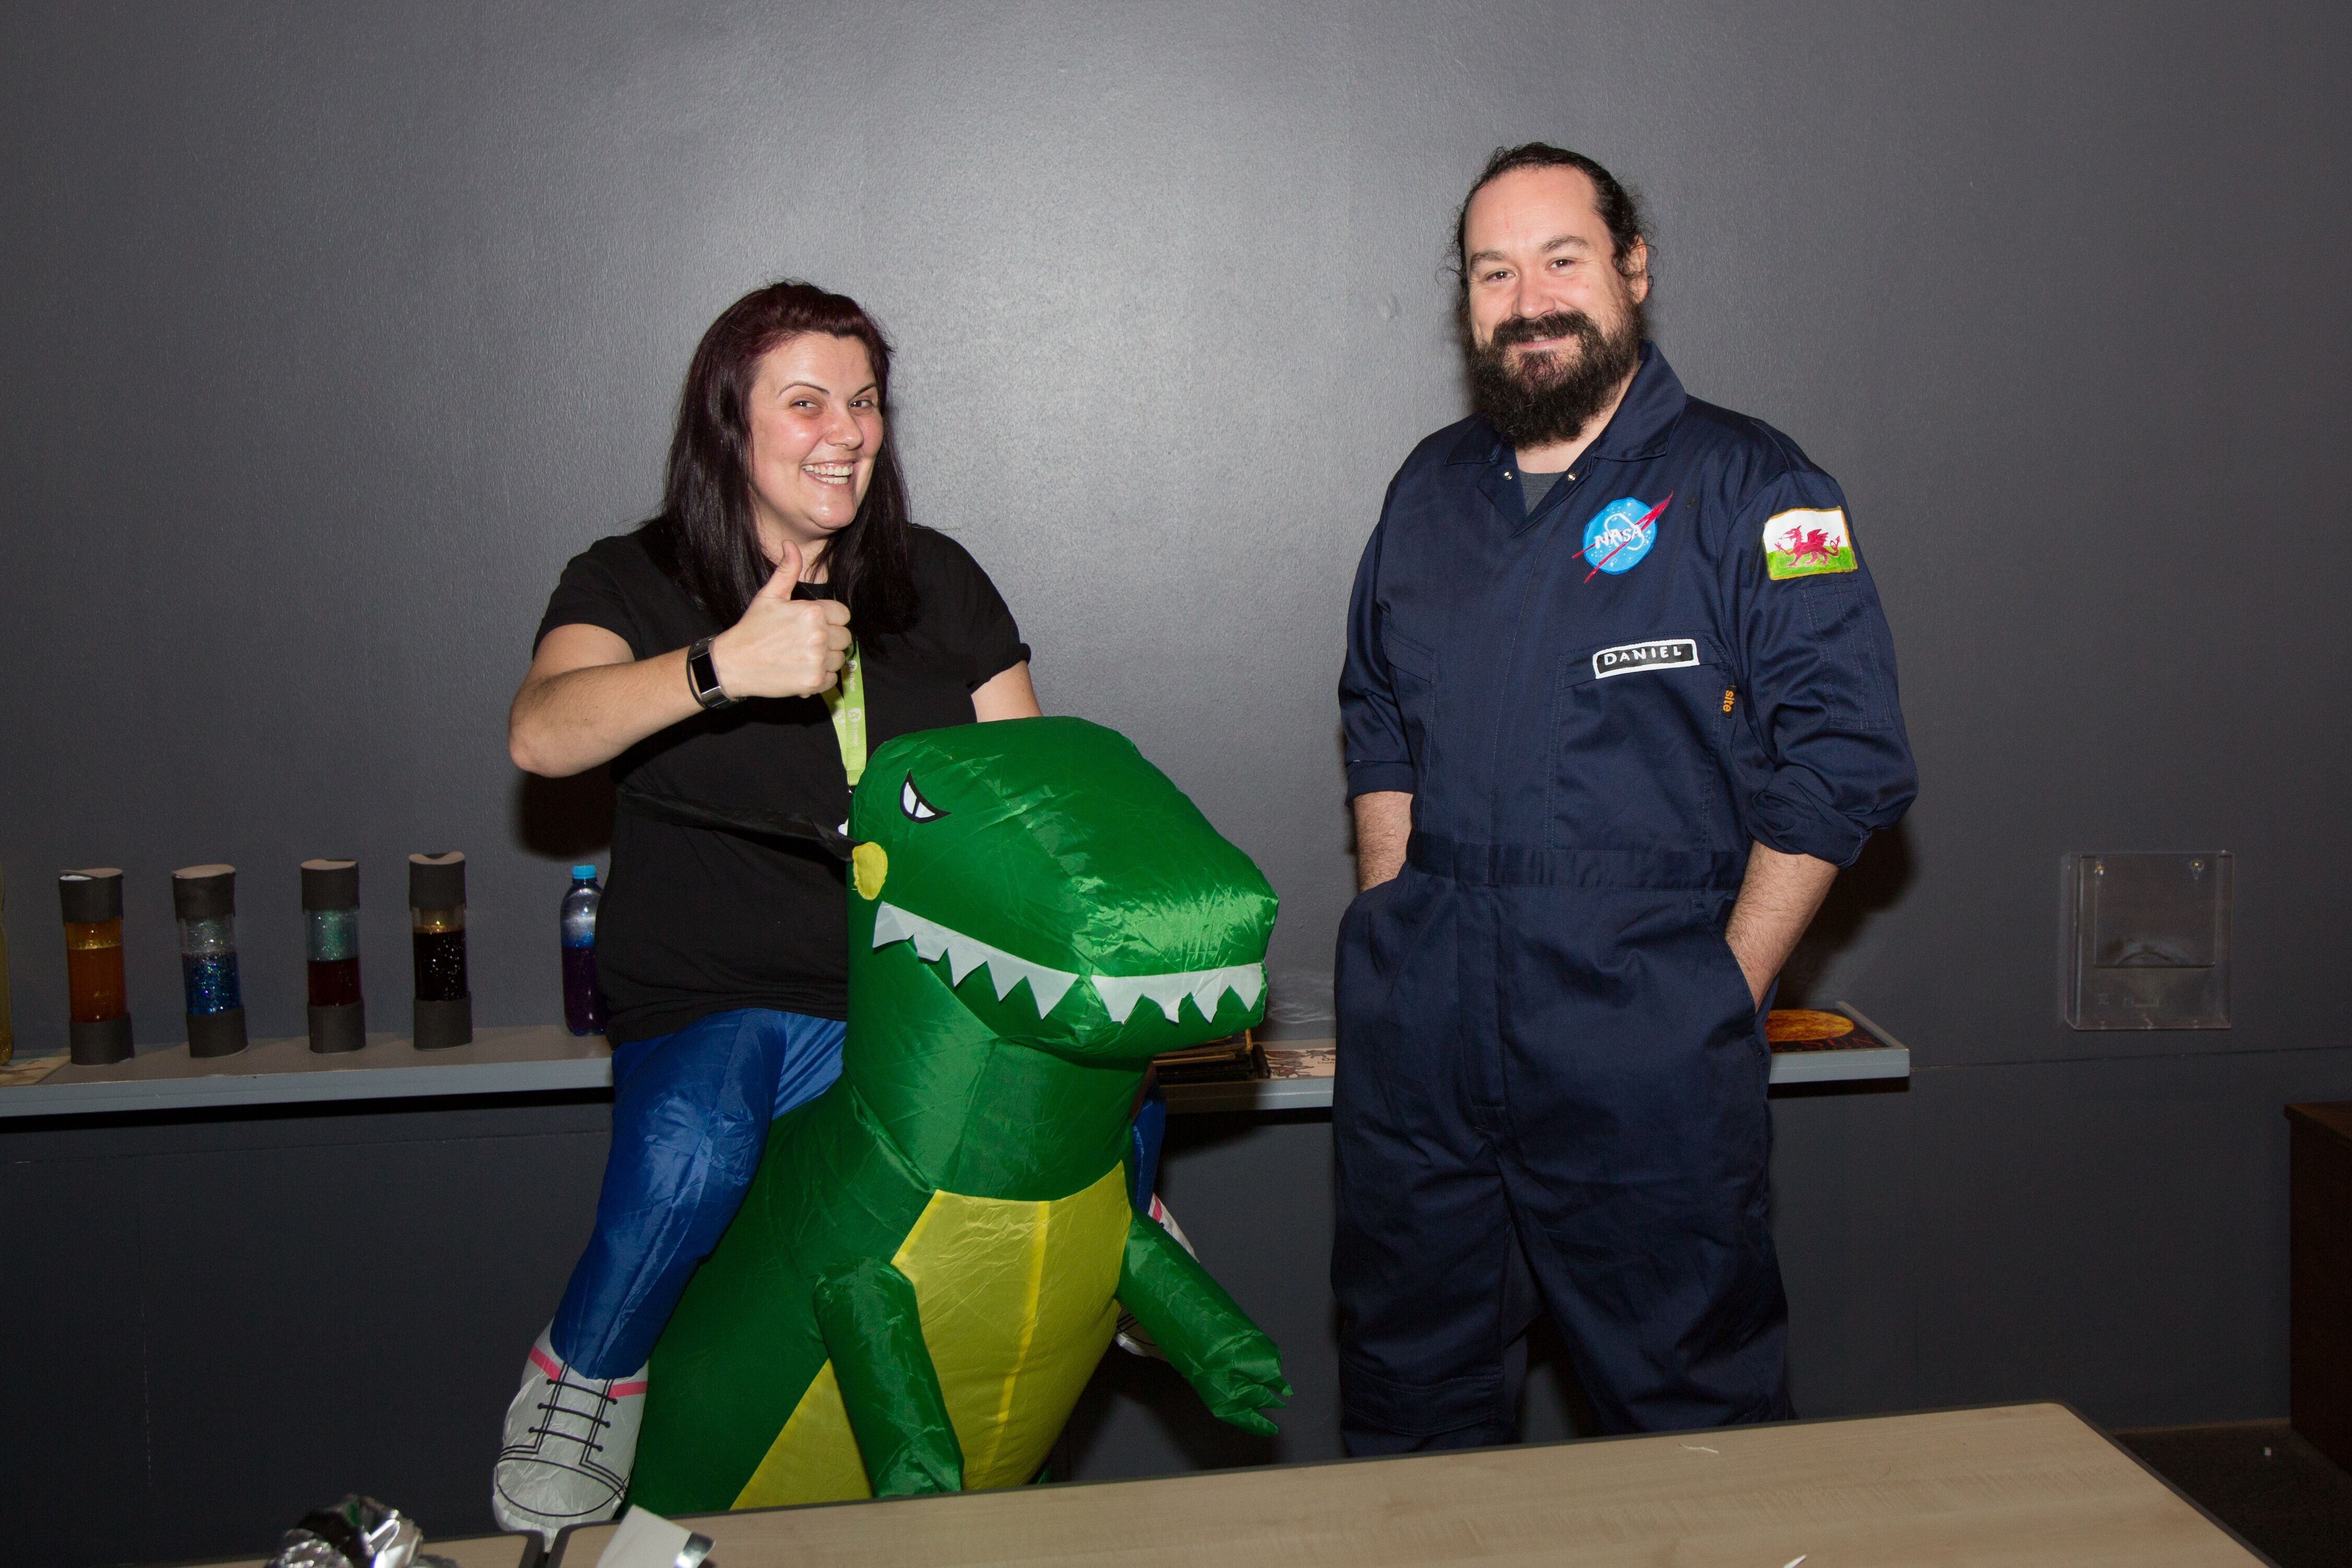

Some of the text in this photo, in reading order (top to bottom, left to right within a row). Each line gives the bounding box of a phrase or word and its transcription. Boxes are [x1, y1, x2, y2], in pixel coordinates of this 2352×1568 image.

[1594, 525, 1641, 549] NASA
[1604, 646, 1682, 666] DANIEL
[1723, 690, 1735, 712] site
